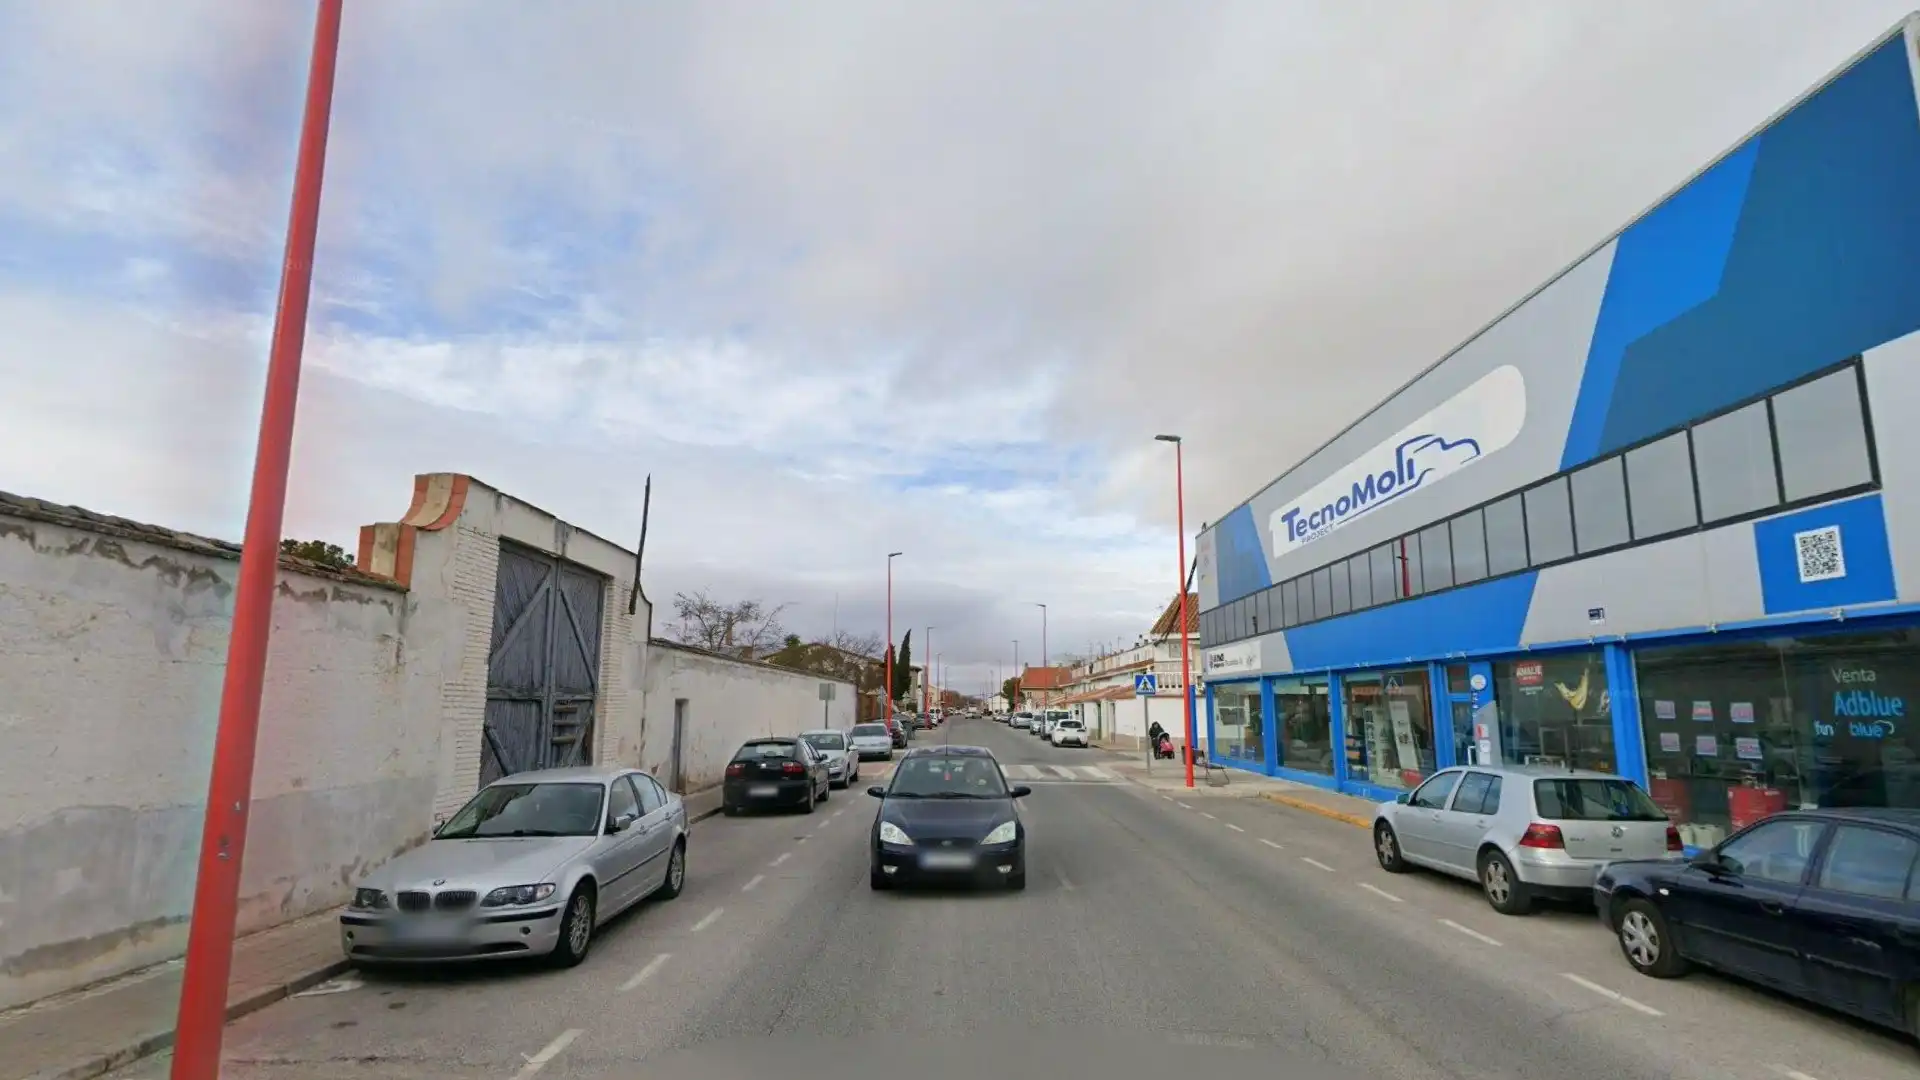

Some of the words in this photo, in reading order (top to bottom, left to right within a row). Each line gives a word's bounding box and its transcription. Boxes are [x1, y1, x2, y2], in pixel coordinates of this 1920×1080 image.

[1300, 523, 1334, 544] PROJECT
[1831, 667, 1876, 683] Venta
[1834, 690, 1904, 716] Adblue
